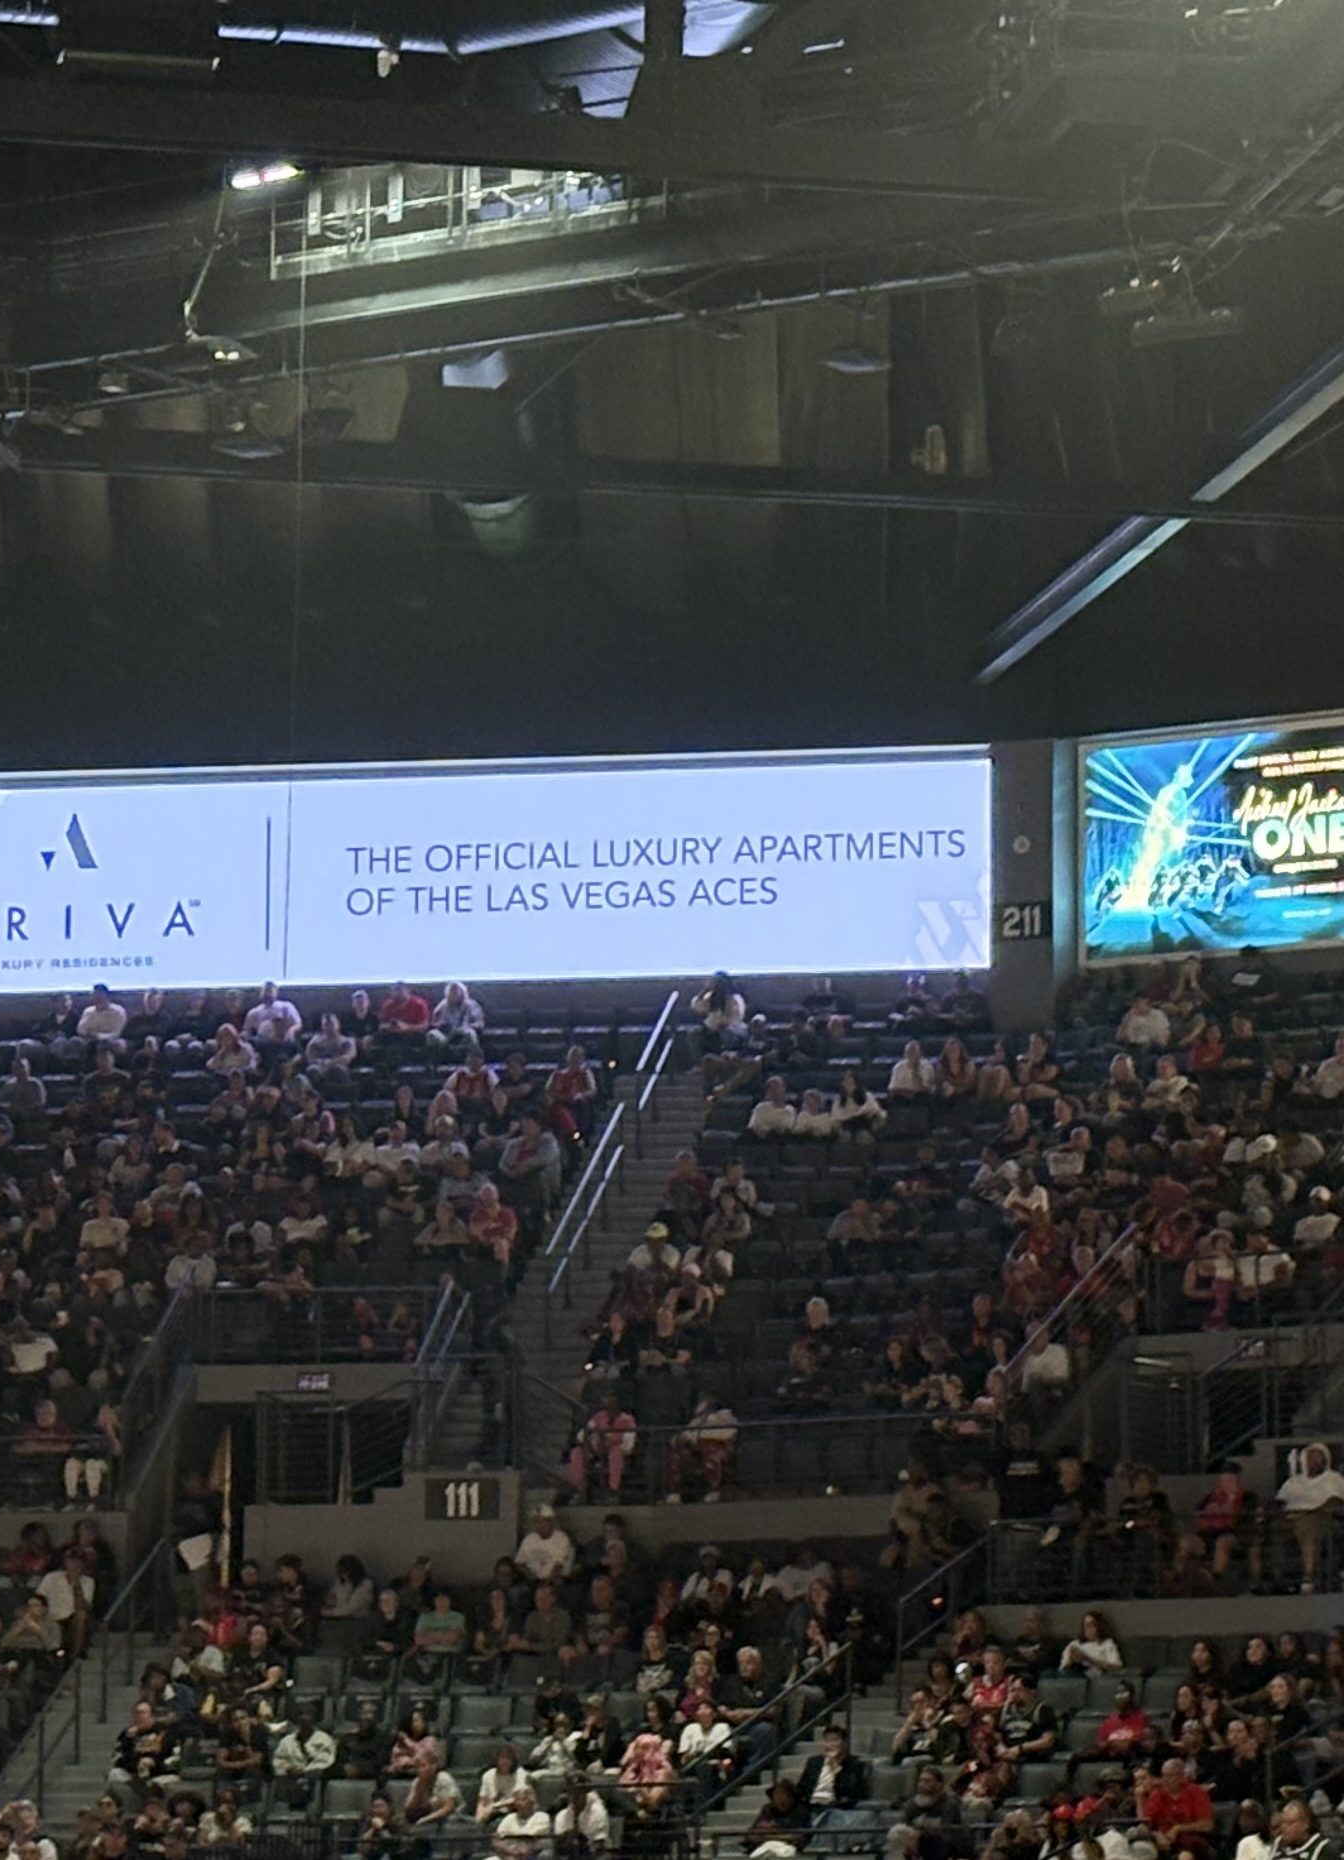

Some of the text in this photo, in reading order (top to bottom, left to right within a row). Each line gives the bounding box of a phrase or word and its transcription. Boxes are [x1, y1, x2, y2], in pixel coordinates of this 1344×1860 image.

[346, 829, 966, 875] THE OFFICIAL LUXURY APARTMENTS
[346, 877, 778, 916] OF THE LAS VEGAS ACES
[1002, 905, 1041, 937] 211
[445, 1482, 480, 1518] 111
